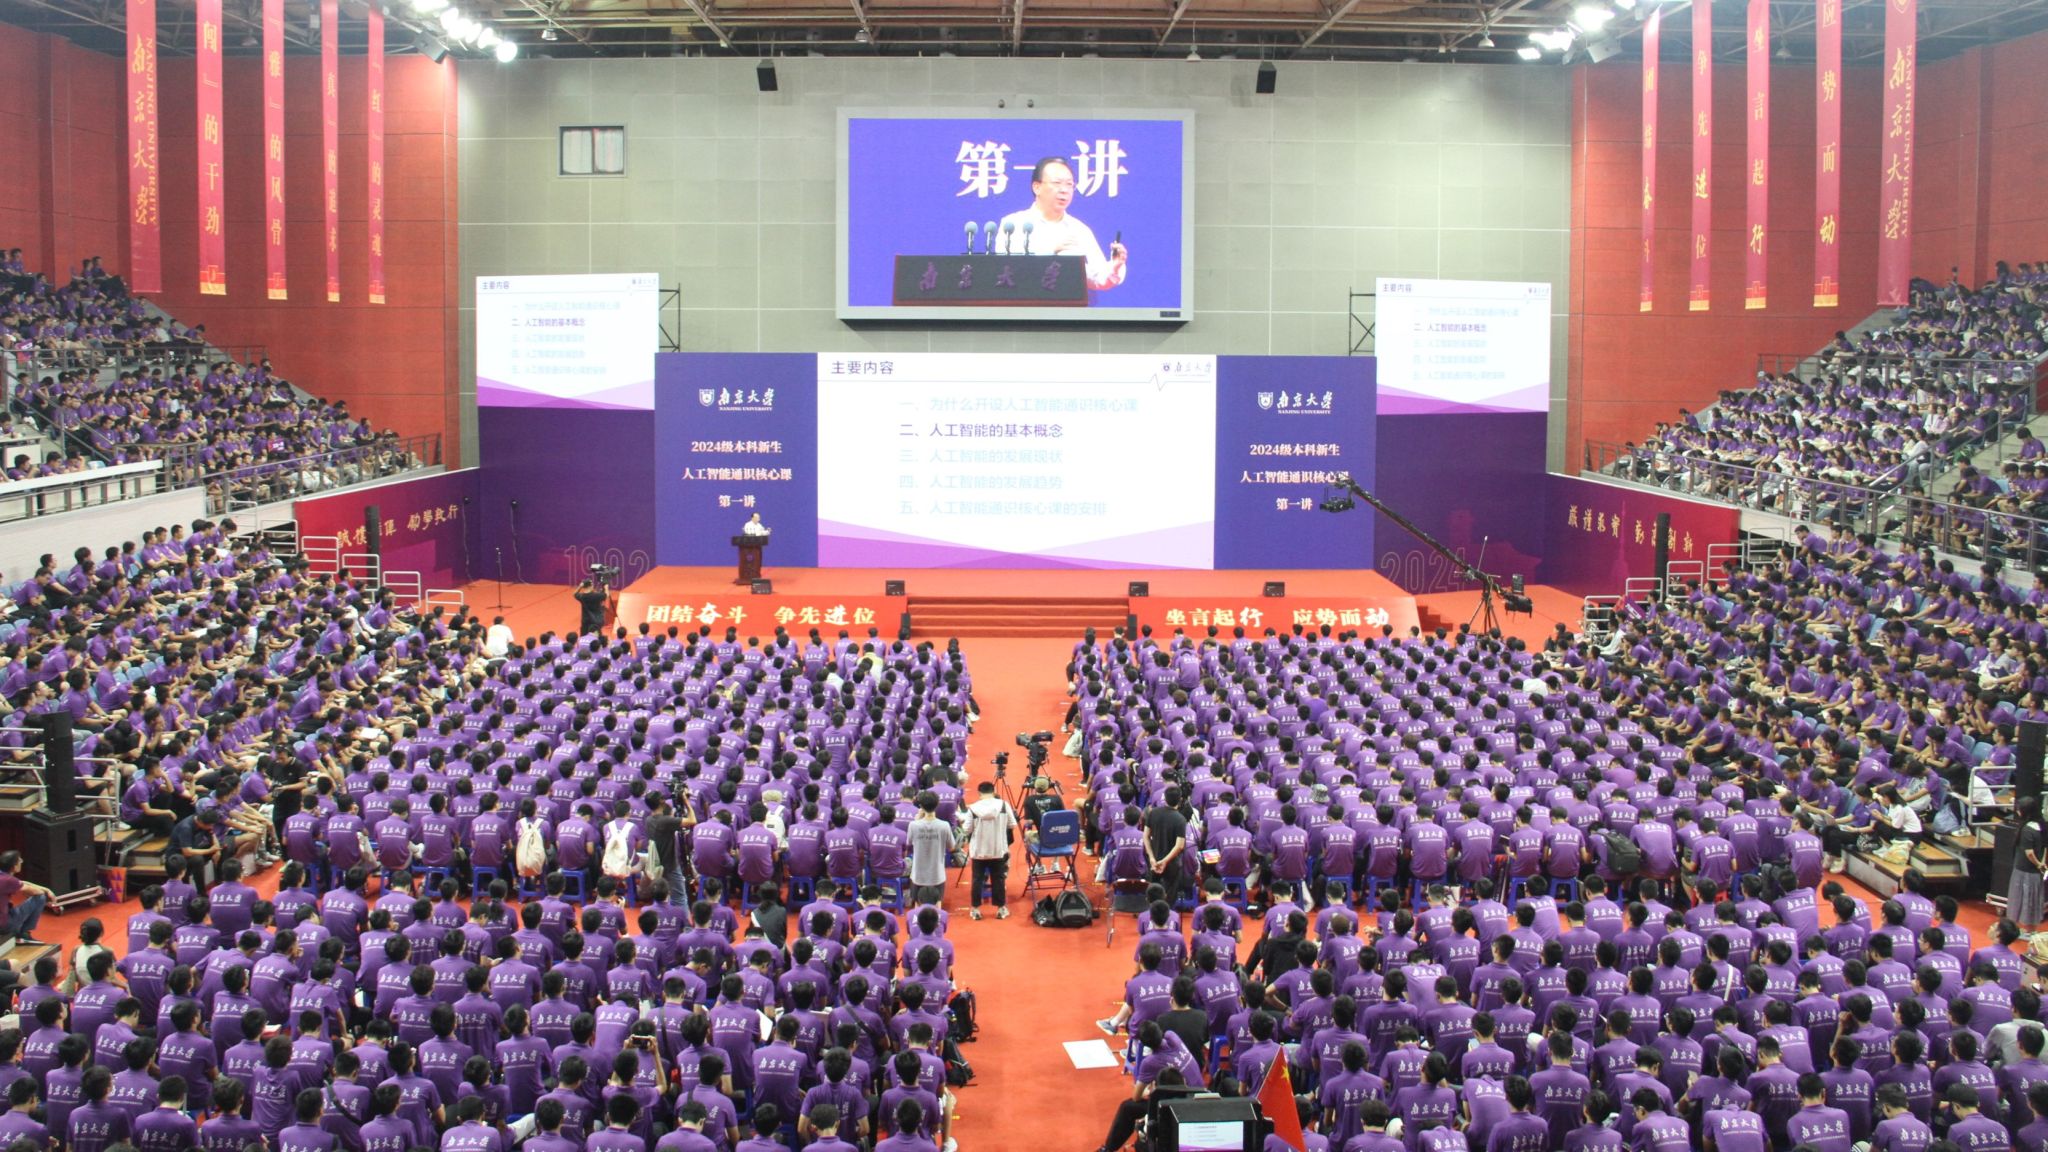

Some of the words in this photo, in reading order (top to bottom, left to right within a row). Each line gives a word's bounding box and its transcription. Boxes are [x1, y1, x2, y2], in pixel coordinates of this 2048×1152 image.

[831, 360, 895, 376] 主要内容
[691, 440, 782, 454] 2024级本科新生
[1250, 443, 1340, 457] 2024级本科新生
[682, 467, 792, 481] 人工智能通识核心课
[718, 495, 756, 508] 第一讲
[1276, 497, 1313, 511] 第一讲
[646, 603, 748, 625] 团结奋斗
[774, 605, 876, 627] 争先进位
[1165, 607, 1264, 628] 坐言起行
[1293, 607, 1390, 628] 应势而动
